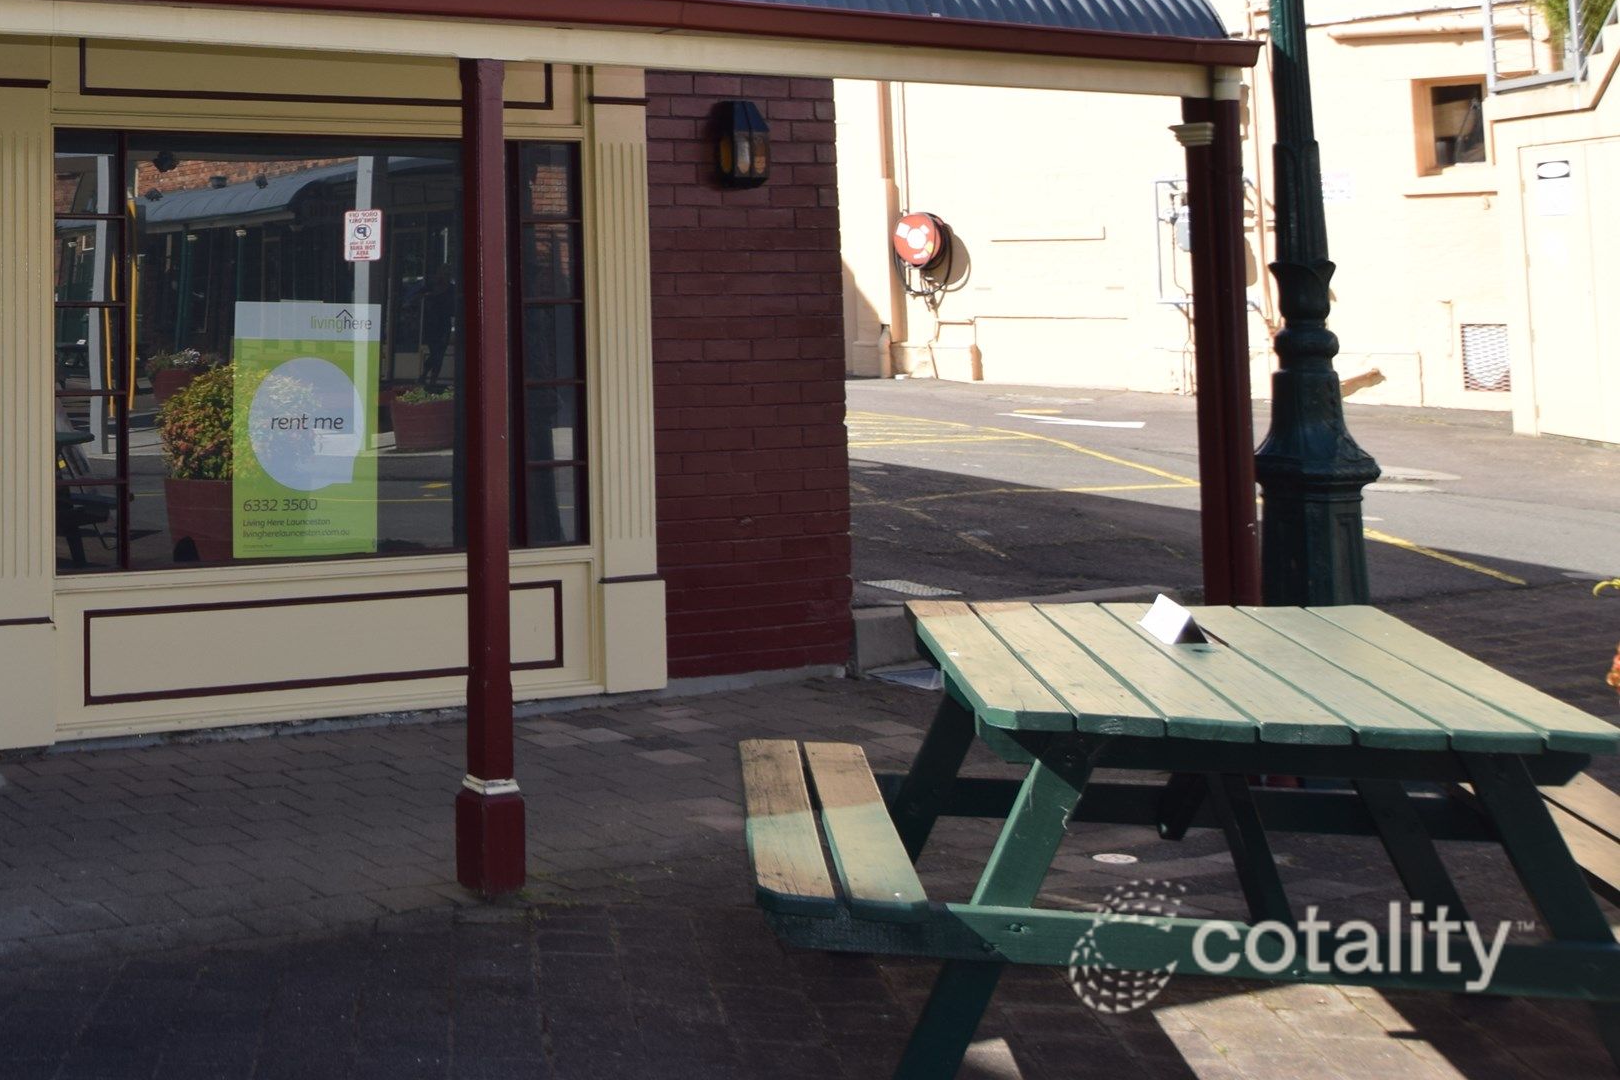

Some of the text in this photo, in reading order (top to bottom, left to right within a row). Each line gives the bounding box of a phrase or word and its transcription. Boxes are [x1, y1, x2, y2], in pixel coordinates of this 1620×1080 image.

[310, 315, 372, 333] livinghere
[270, 413, 344, 430] rent me
[243, 498, 318, 512] 6332 3500
